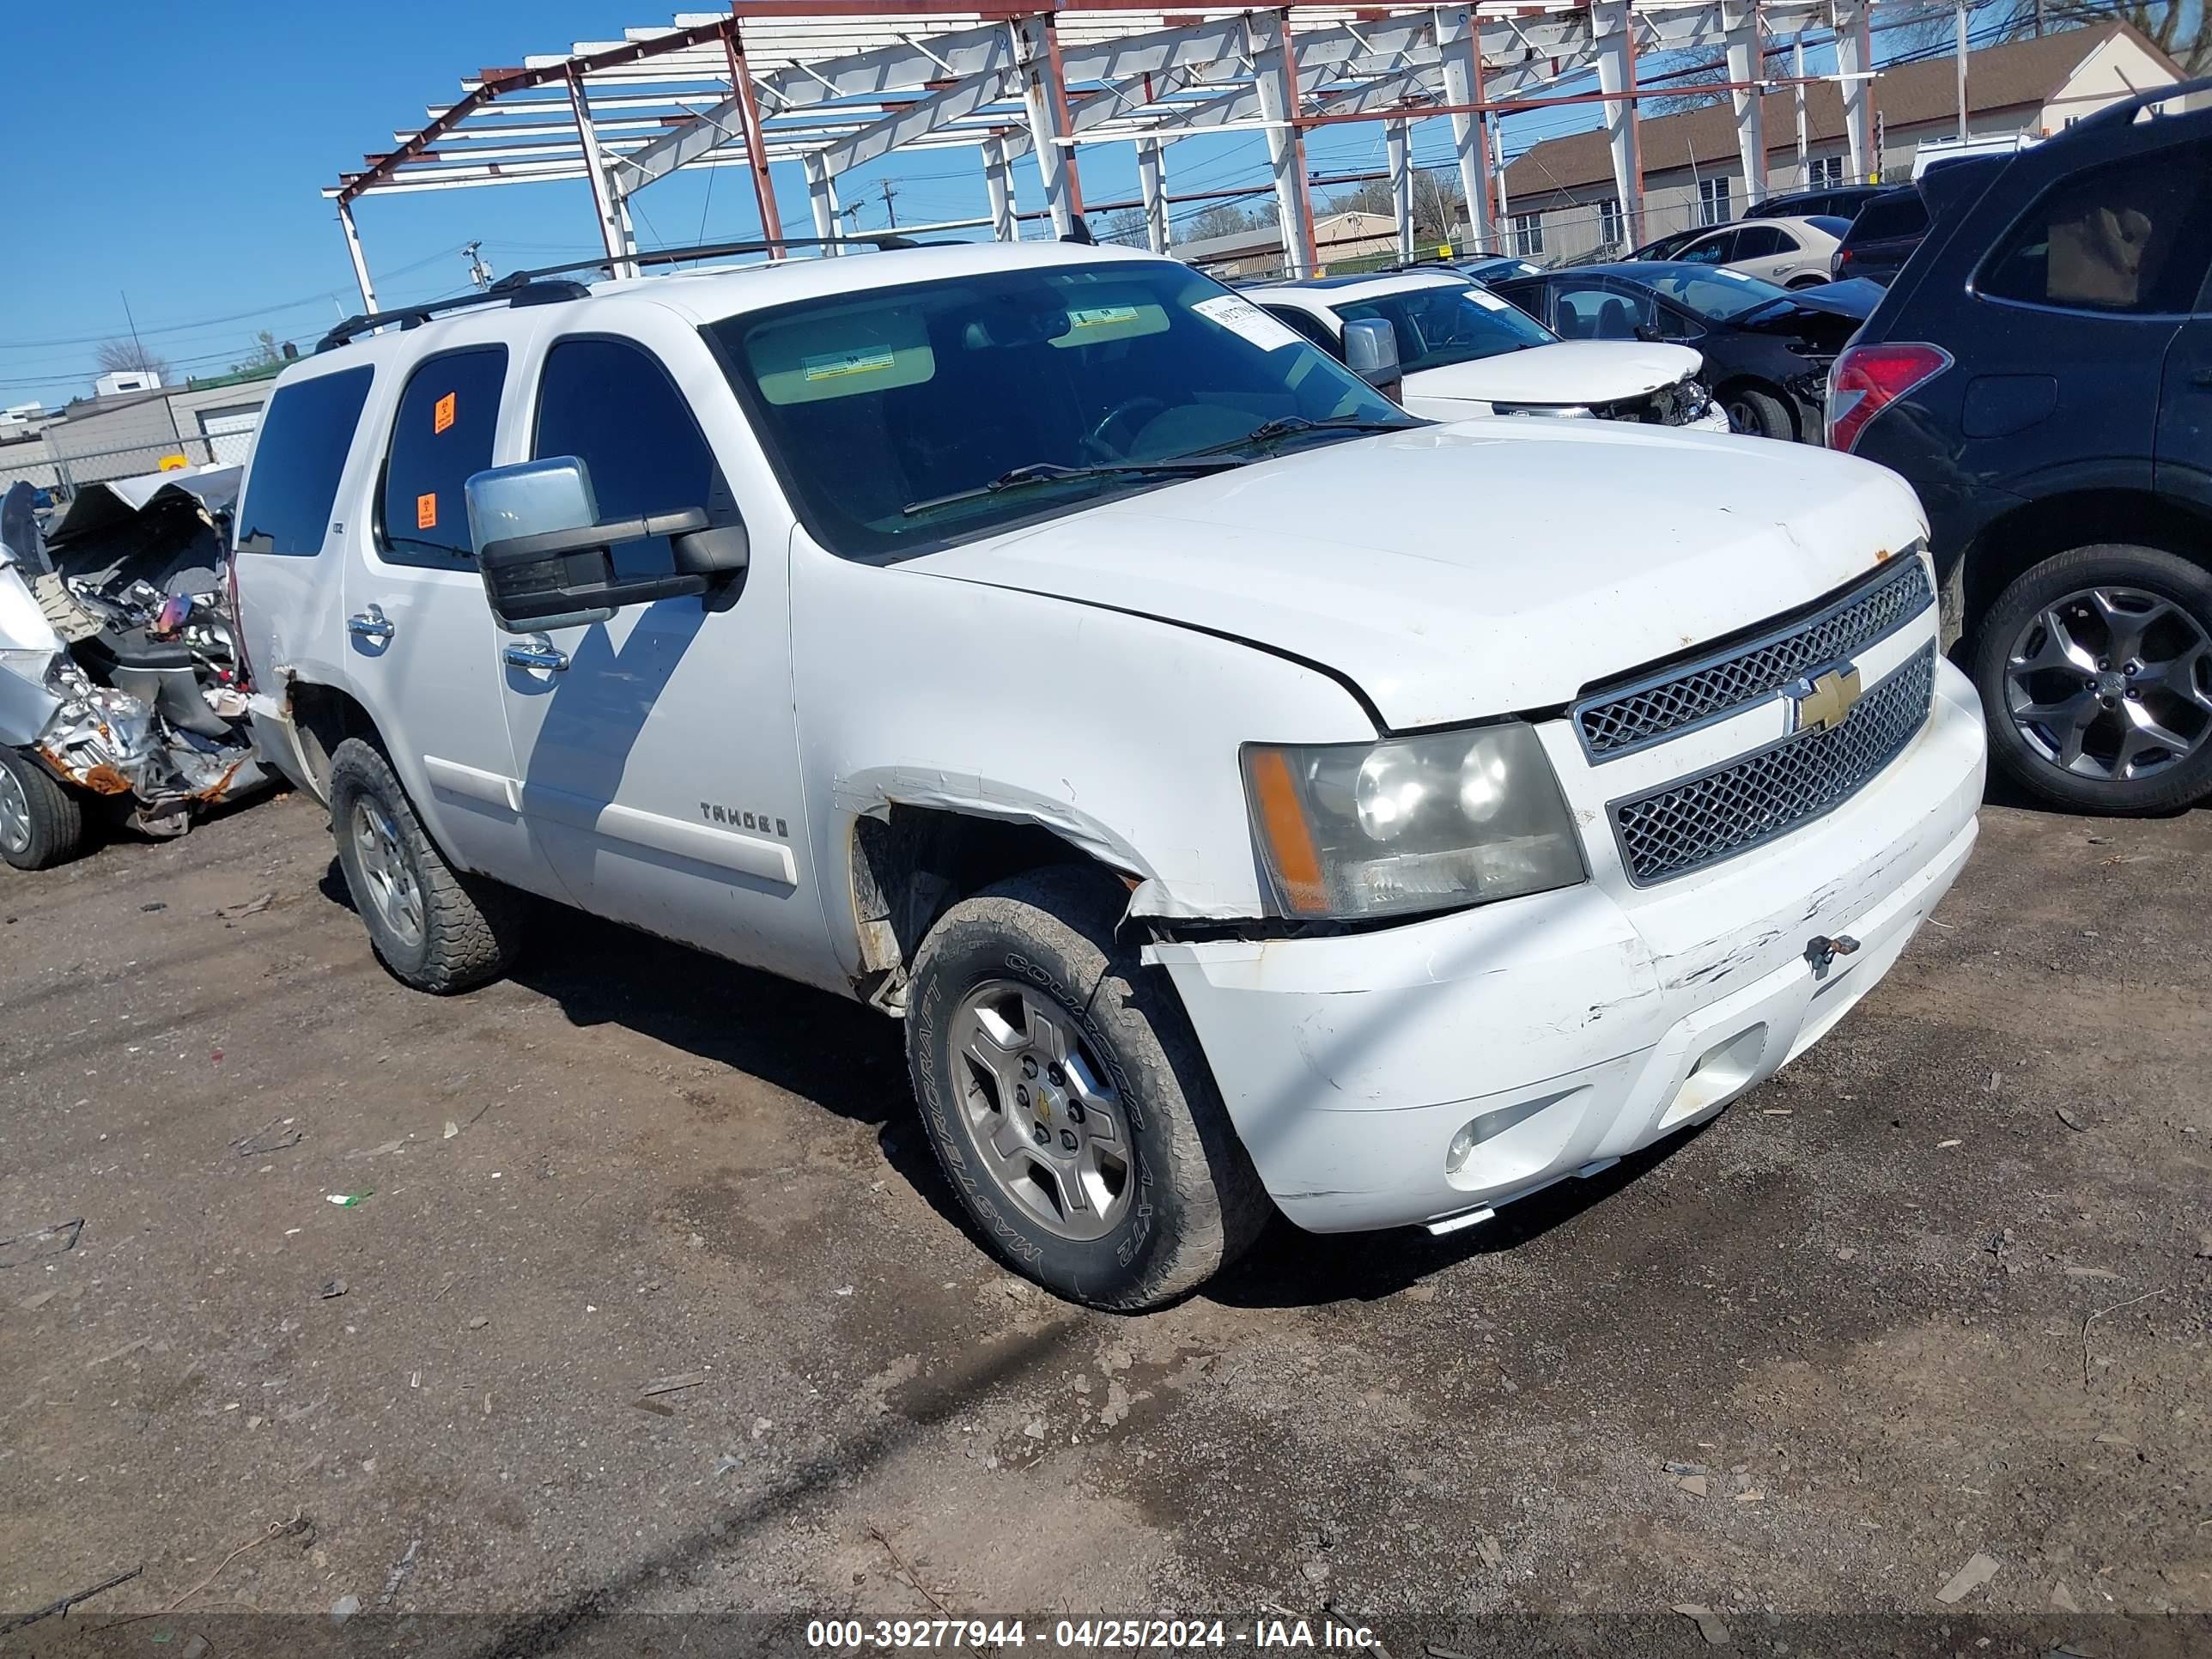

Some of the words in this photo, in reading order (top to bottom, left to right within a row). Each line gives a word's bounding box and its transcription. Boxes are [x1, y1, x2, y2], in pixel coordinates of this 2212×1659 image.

[700, 801, 771, 833] TAHOE
[919, 973, 1043, 1262] MASTERCRAFT
[1005, 952, 1145, 1130] COURSER
